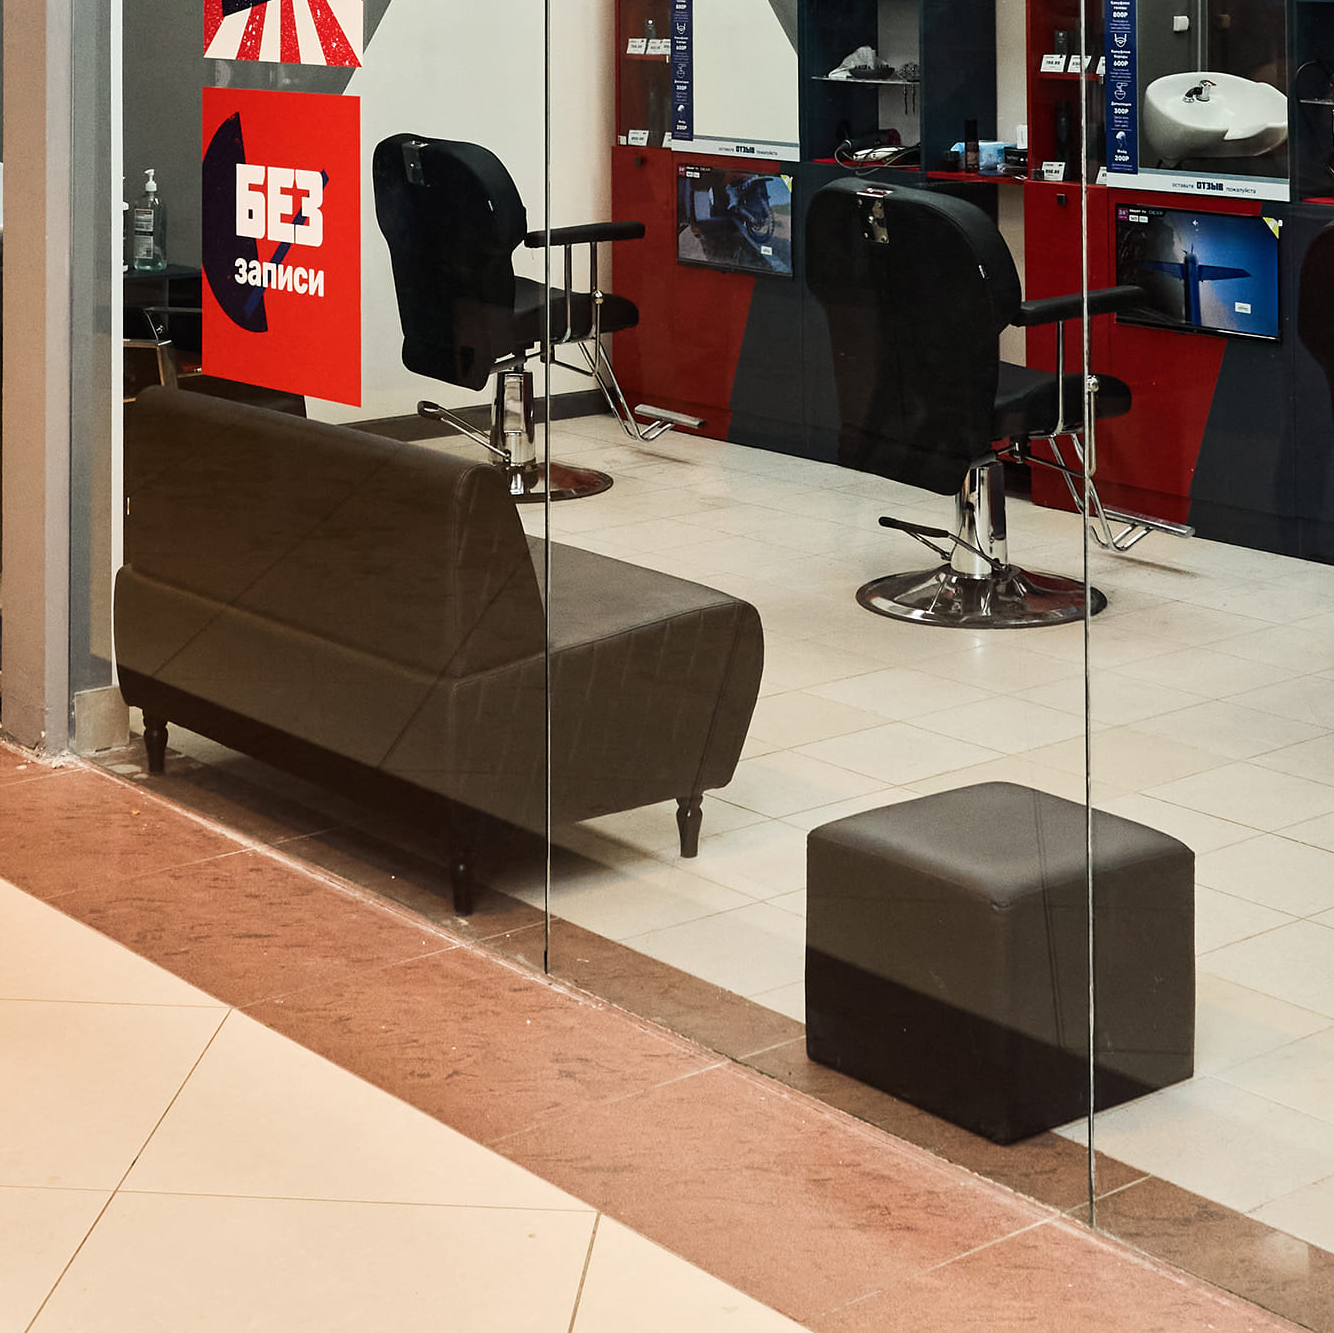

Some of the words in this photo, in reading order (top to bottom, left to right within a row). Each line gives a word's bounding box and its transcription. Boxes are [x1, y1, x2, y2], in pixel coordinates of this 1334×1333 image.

[236, 163, 323, 247] БЕЗ
[1196, 181, 1224, 191] ОТЗЫВ
[234, 257, 324, 297] записи
